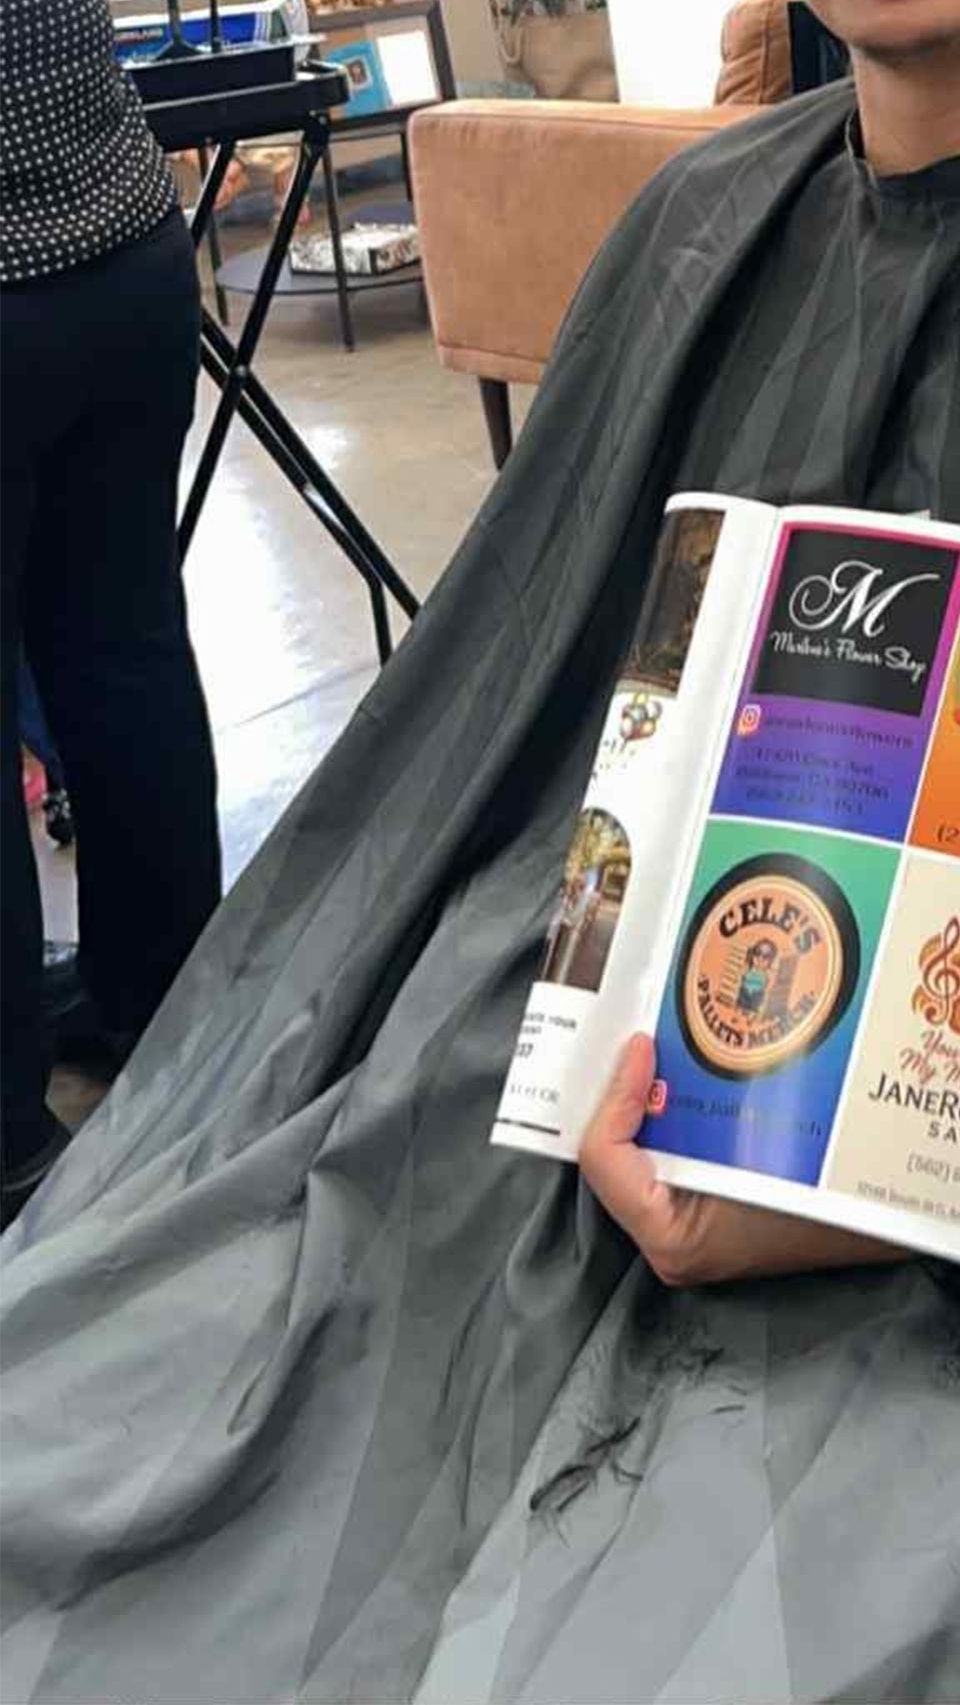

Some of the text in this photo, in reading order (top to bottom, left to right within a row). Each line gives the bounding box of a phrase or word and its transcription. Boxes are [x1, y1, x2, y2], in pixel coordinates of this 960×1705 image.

[884, 646, 928, 684] Shop
[718, 897, 821, 955] CELE'S
[900, 1047, 938, 1086] My
